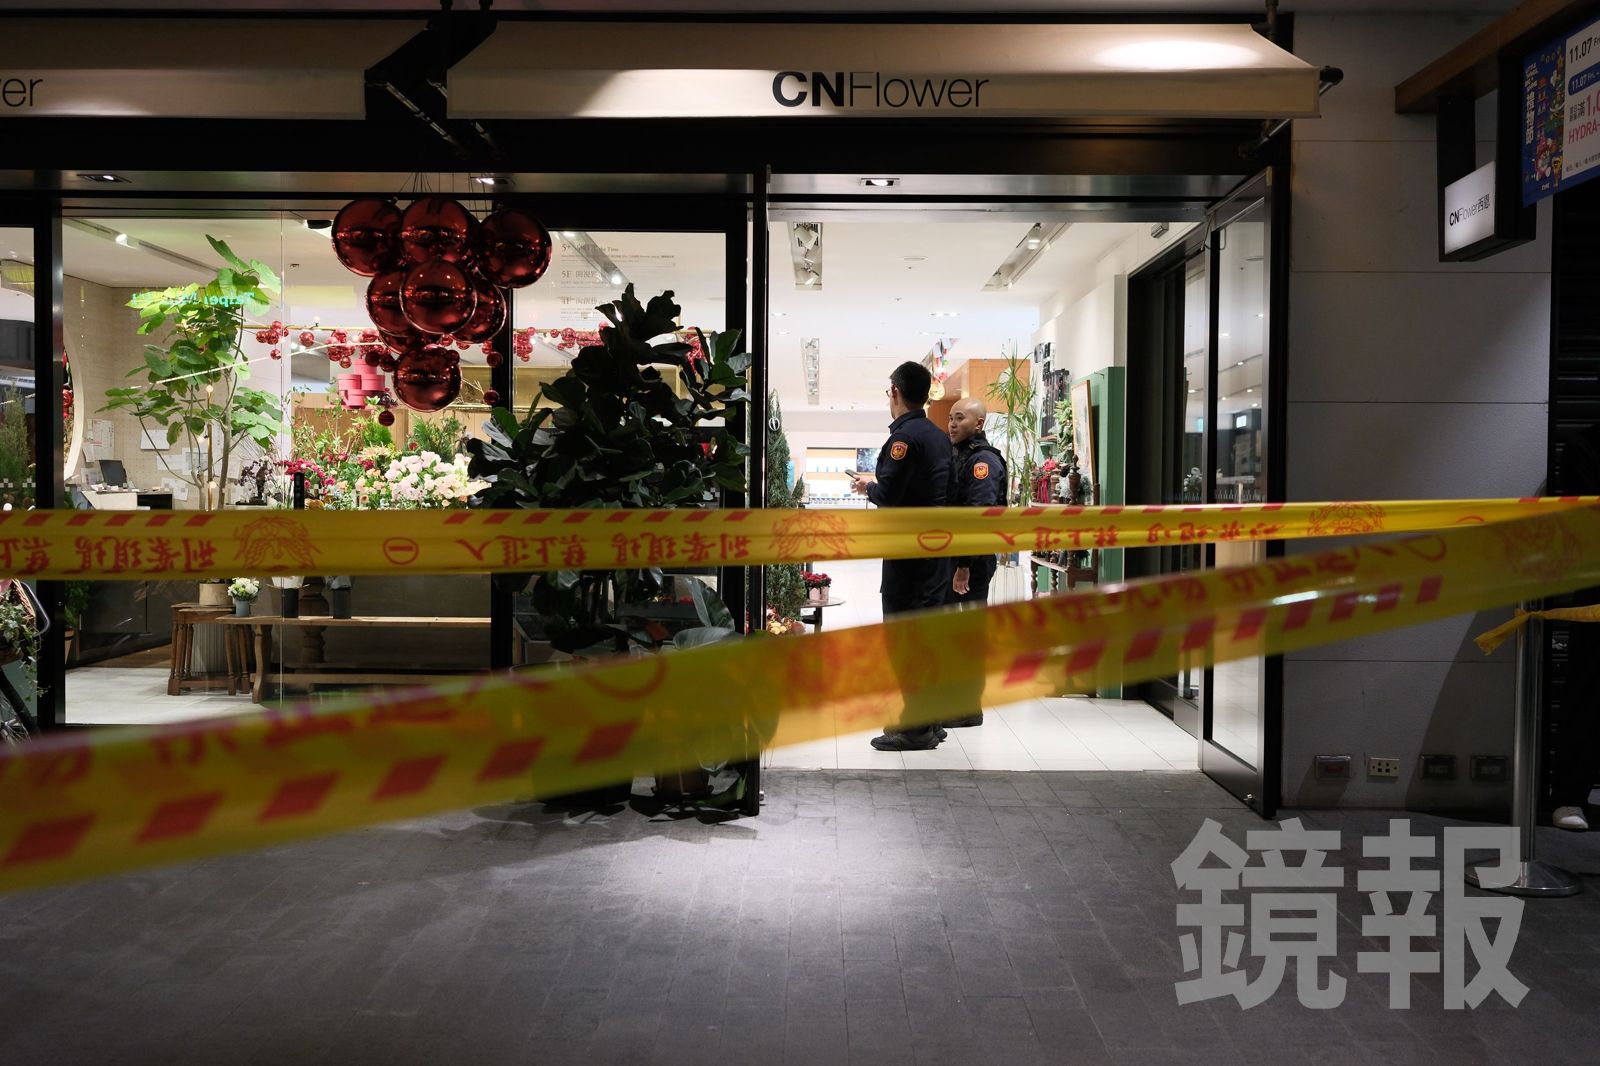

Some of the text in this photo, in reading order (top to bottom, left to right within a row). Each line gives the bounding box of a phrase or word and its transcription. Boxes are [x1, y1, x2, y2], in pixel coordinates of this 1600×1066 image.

[1570, 37, 1593, 64] 11.07
[0, 78, 44, 107] er
[772, 71, 990, 107] CNFlower
[1572, 74, 1587, 91] 11.07
[74, 535, 219, 572] 刑案現場
[453, 531, 753, 568] 刑案現場 禁止進入
